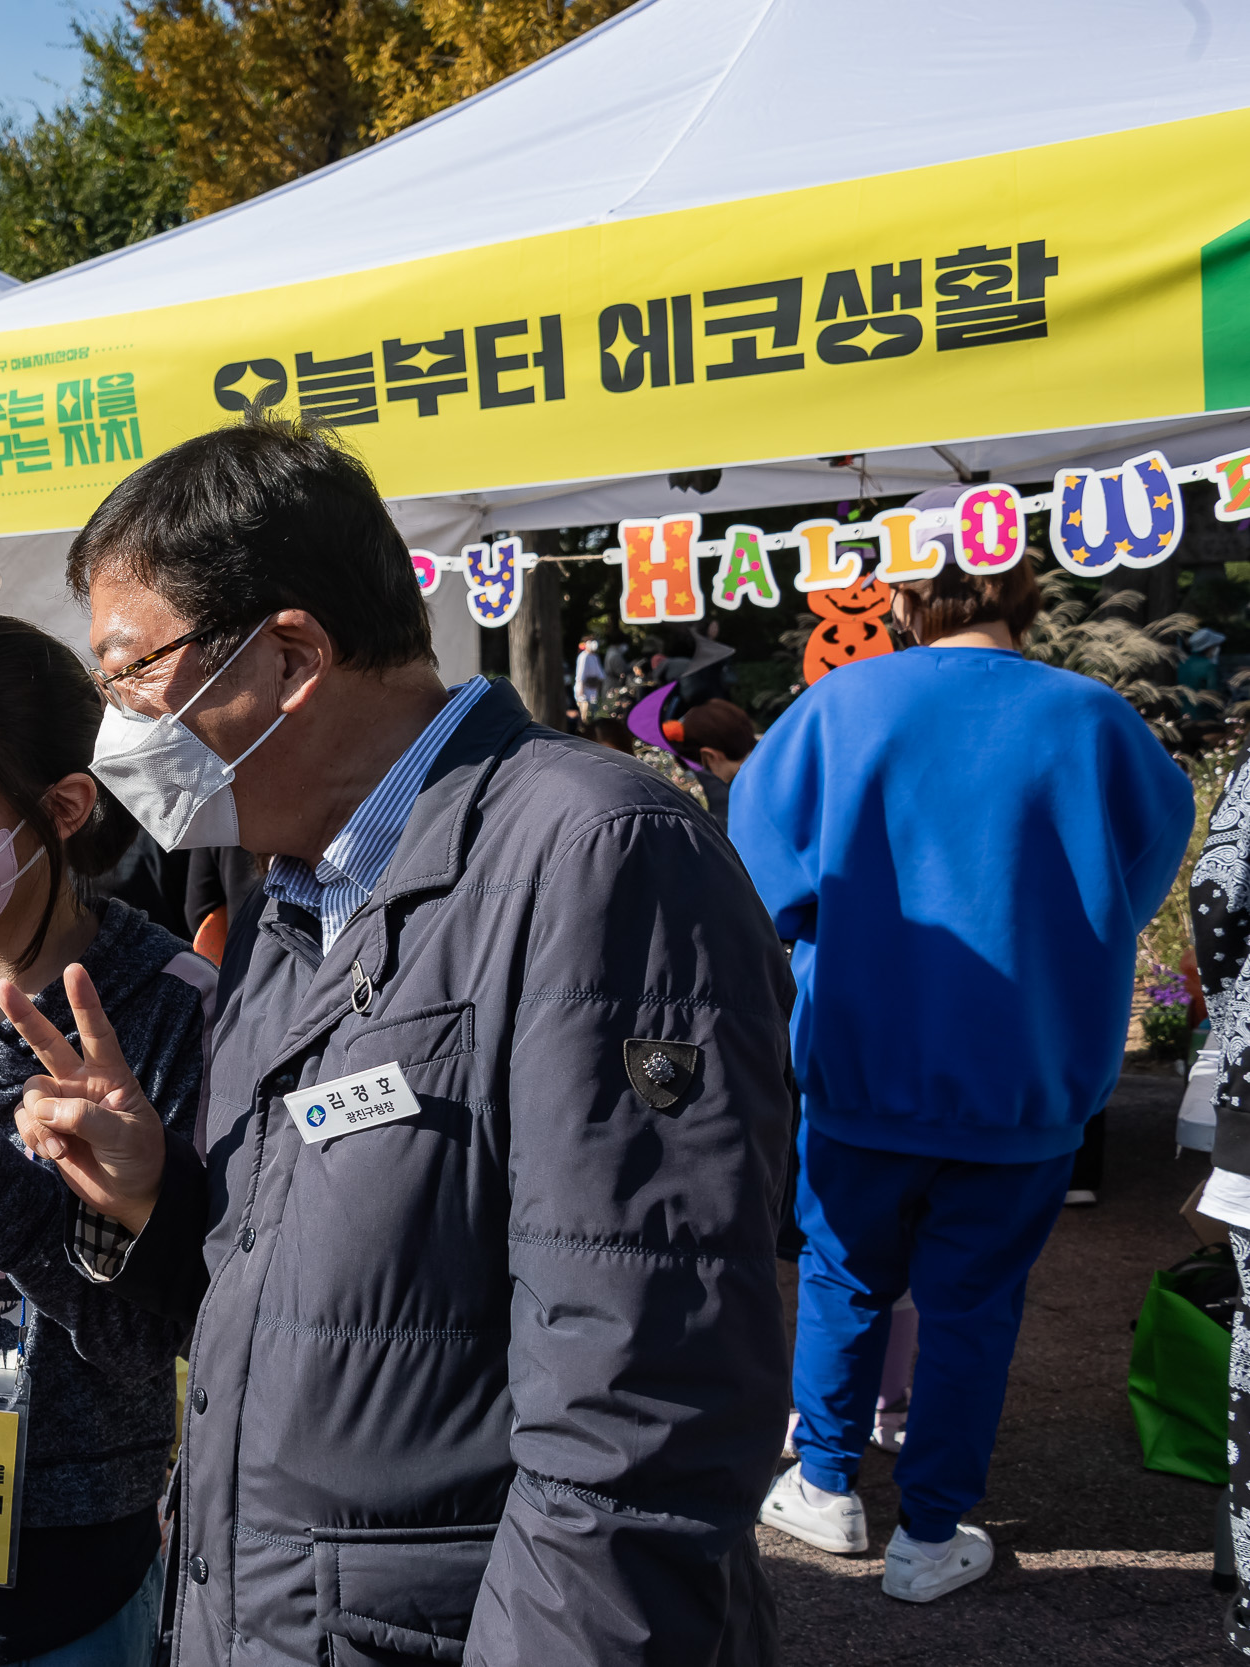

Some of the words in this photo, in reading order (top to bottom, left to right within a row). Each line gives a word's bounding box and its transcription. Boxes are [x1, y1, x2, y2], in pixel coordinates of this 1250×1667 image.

[214, 313, 566, 428] 오늘부터
[598, 239, 1059, 394] 에코생활
[56, 372, 137, 424] 마을
[58, 416, 143, 467] 자치
[345, 1100, 395, 1124] 광진구청장
